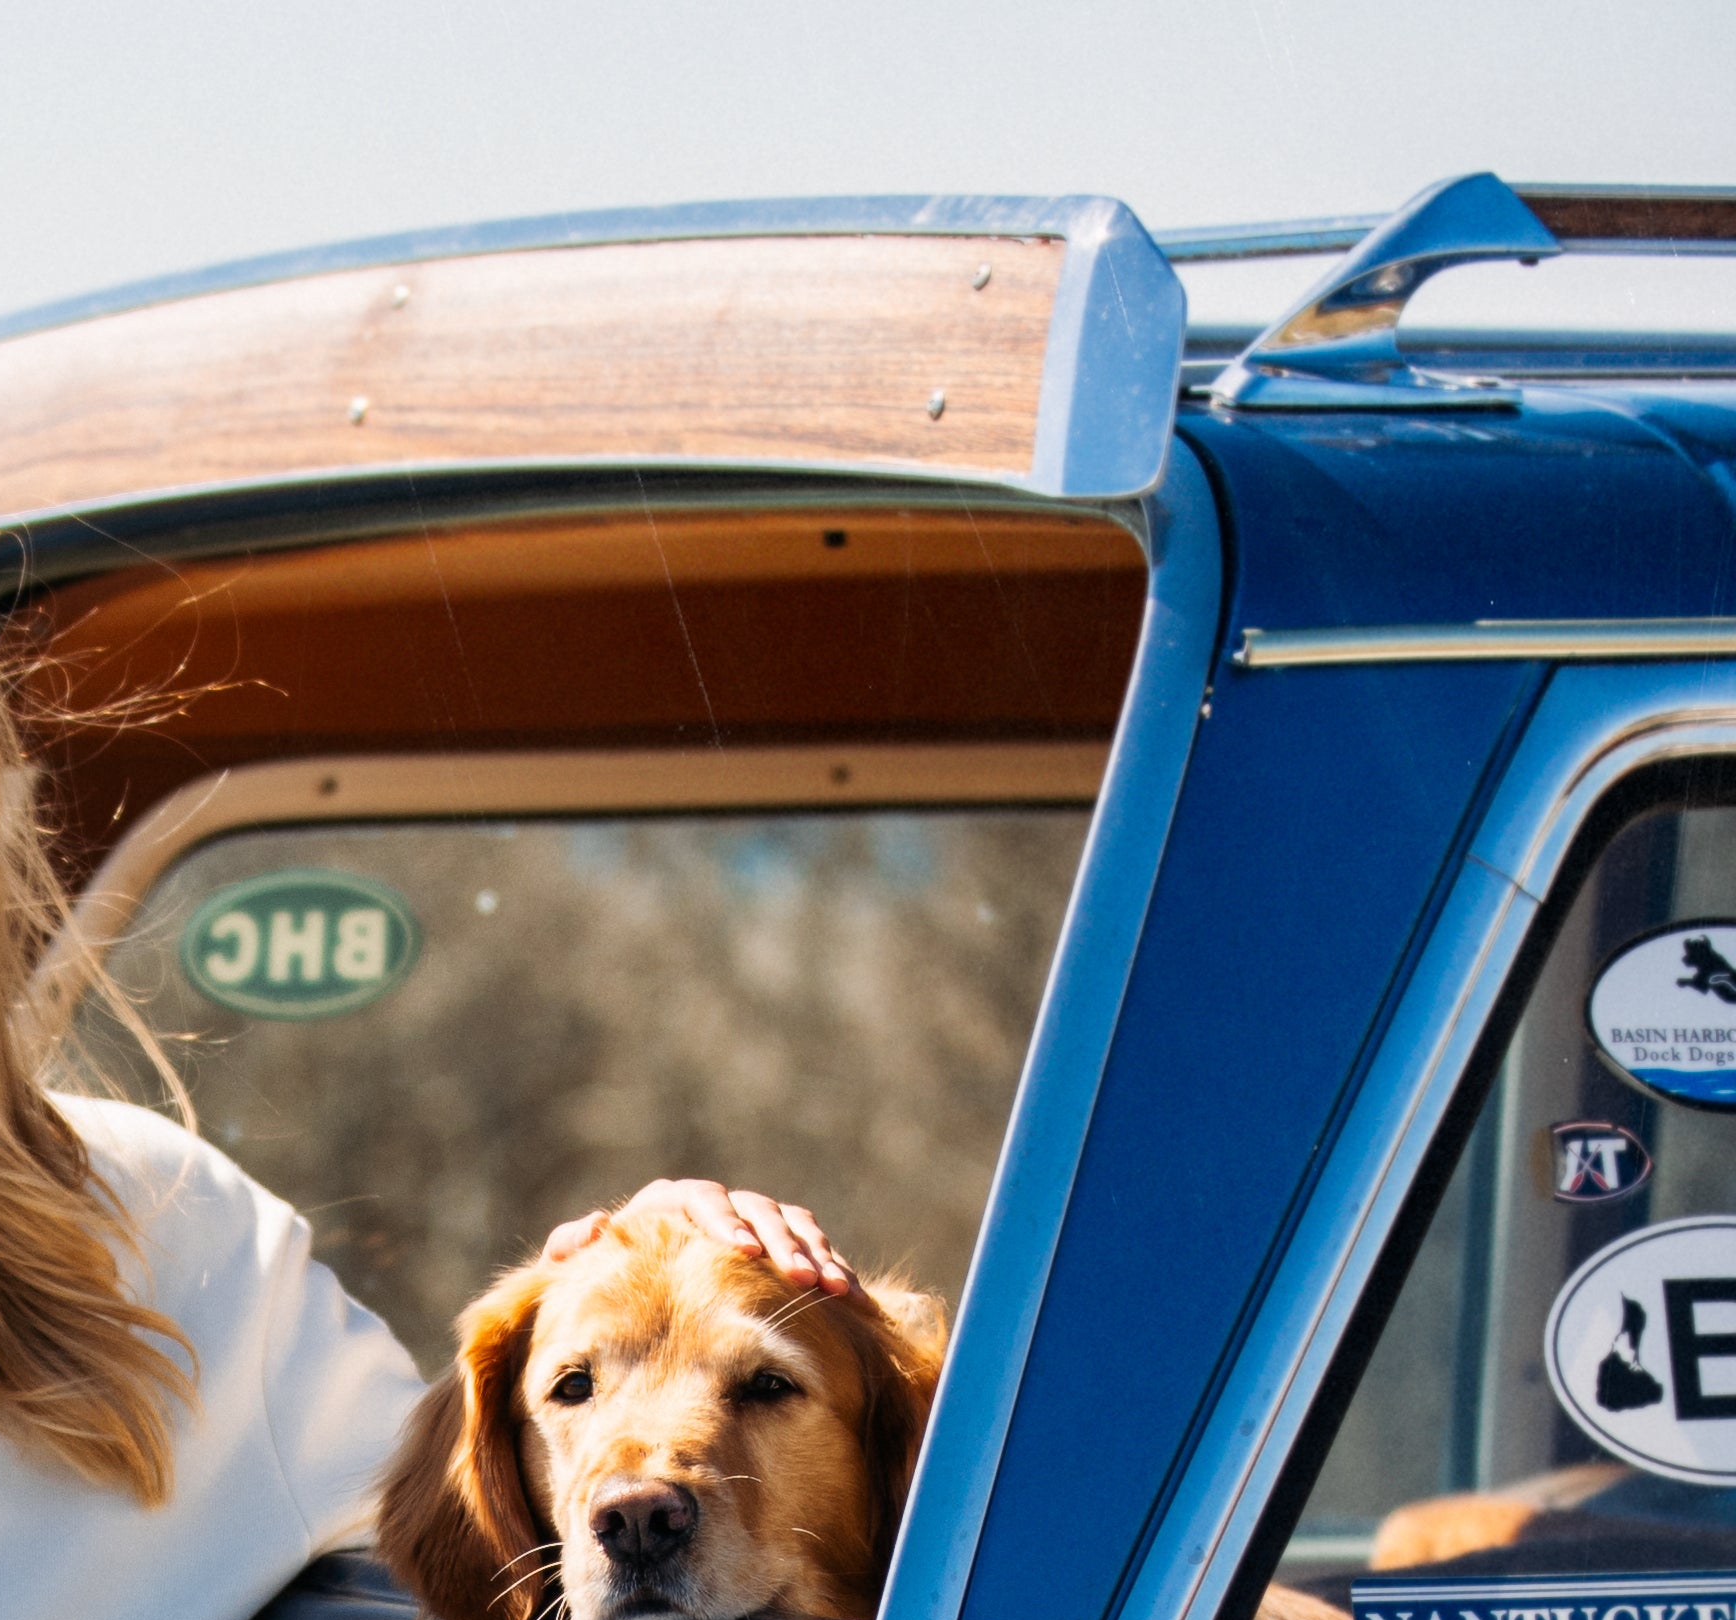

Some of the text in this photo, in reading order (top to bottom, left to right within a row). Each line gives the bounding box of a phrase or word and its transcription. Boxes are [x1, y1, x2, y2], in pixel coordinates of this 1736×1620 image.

[1611, 1027, 1667, 1043] BASIN
[1634, 1046, 1734, 1067] Dock Dogs
